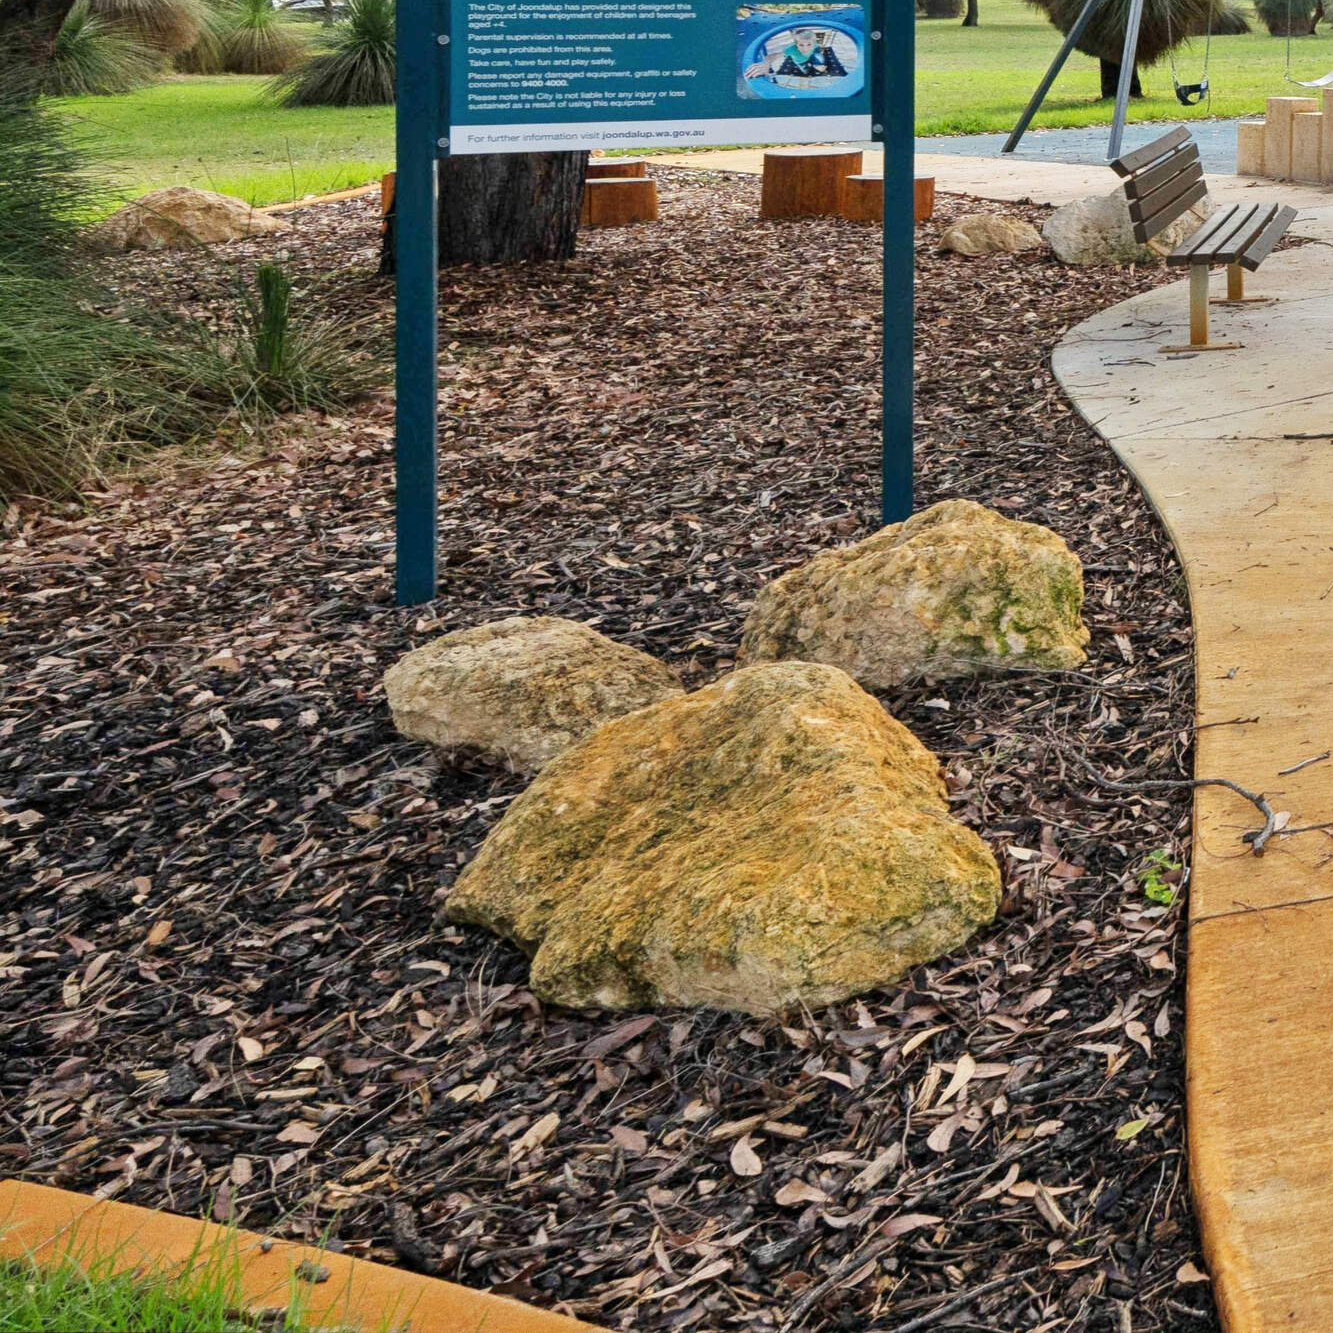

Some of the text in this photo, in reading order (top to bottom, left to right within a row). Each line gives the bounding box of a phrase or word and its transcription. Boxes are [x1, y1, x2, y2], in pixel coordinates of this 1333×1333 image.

[468, 47, 491, 55] Dogs
[509, 46, 552, 54] prohibited
[591, 58, 616, 66] safely.
[634, 70, 660, 78] graffiti
[536, 93, 553, 101] City
[467, 130, 705, 143] For further information visit joondalup.wa.gov.au
